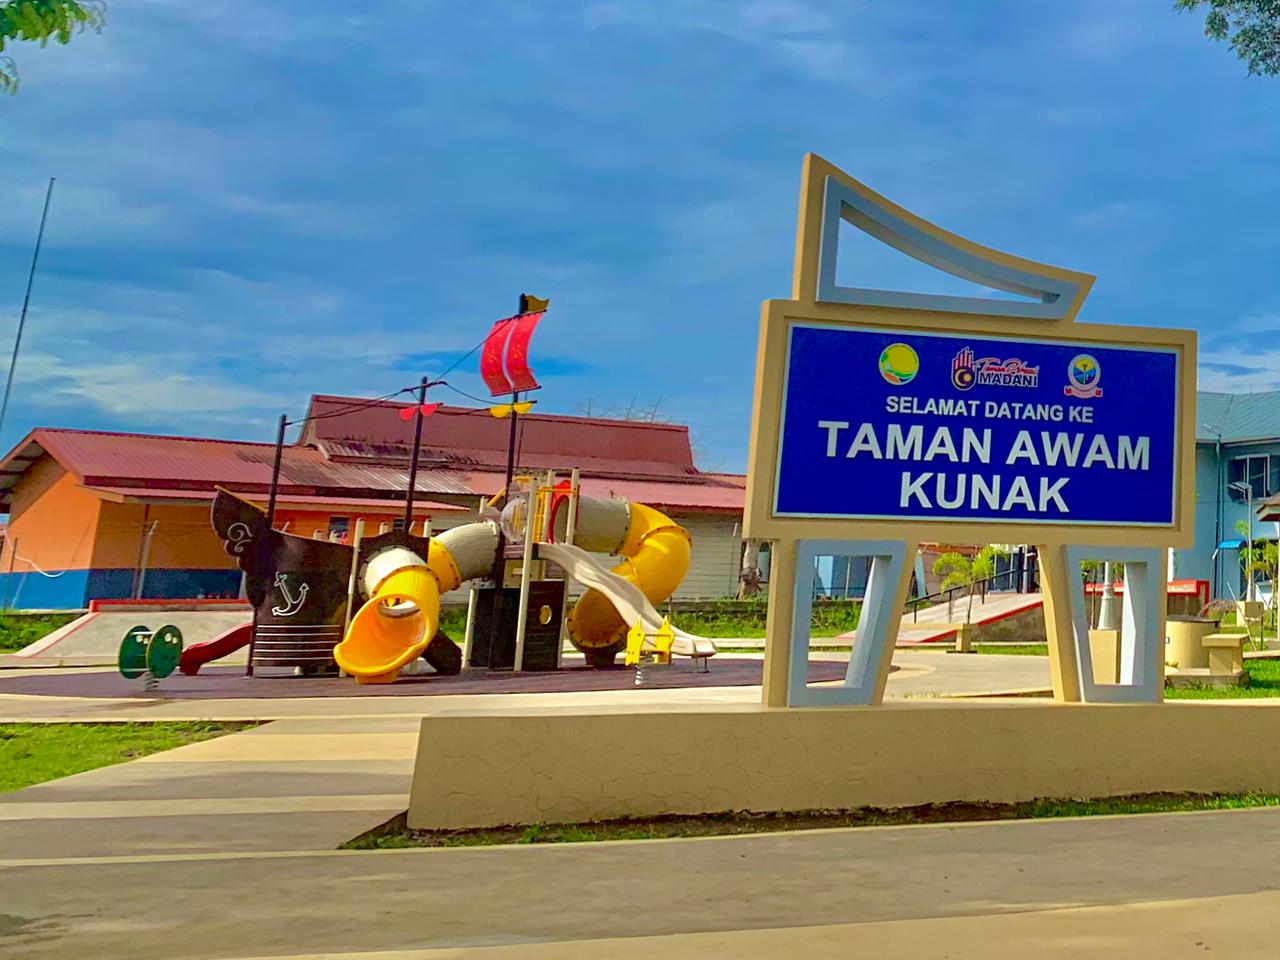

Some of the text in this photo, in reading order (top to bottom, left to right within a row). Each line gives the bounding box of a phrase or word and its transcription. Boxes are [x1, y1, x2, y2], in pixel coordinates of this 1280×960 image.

[978, 371, 1038, 387] MADANI
[886, 396, 1093, 423] SELAMAT DATANG KE
[818, 420, 1150, 470] TAMAN AWAM
[899, 471, 1070, 513] KUNAK
